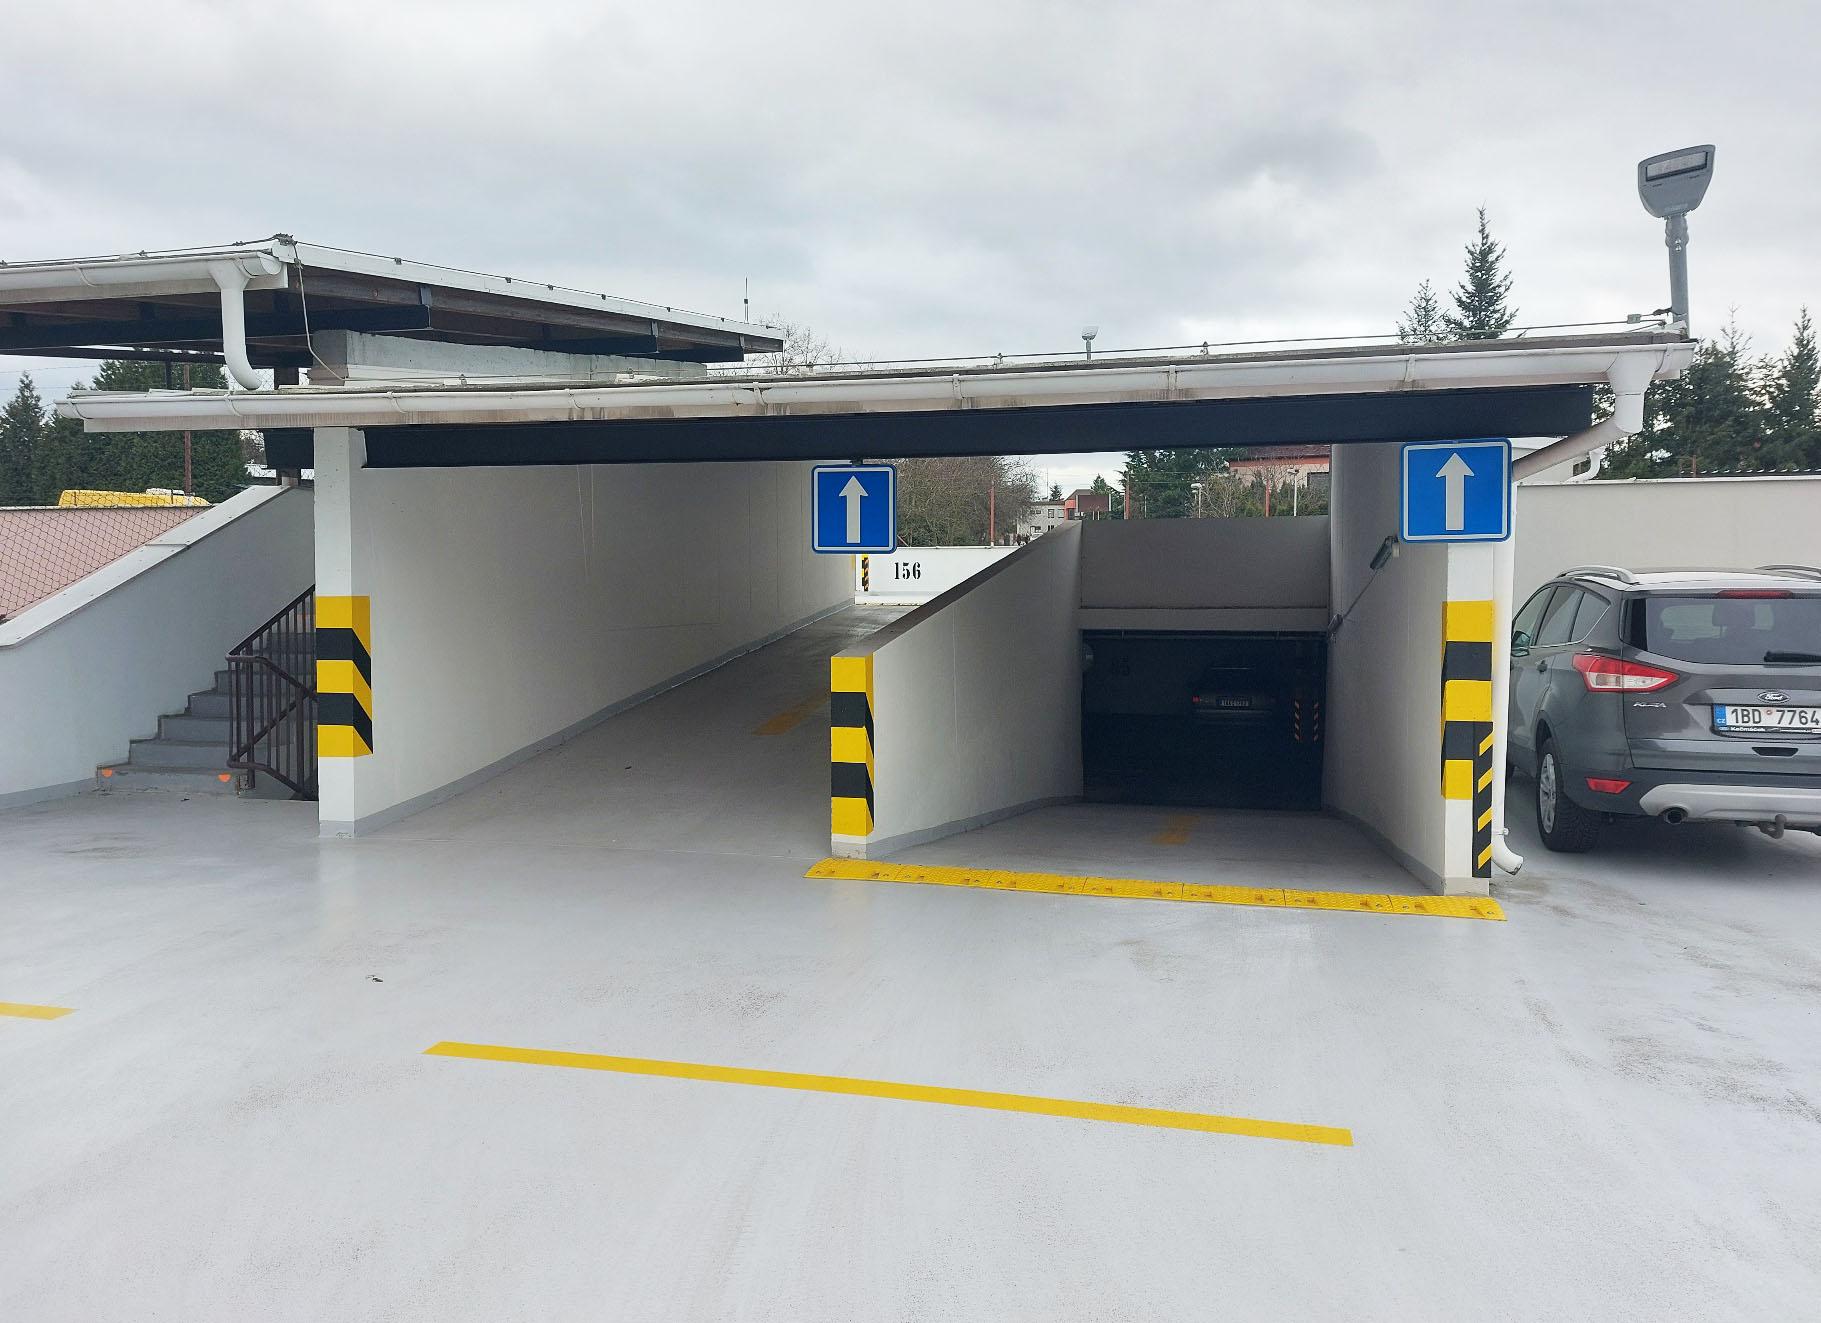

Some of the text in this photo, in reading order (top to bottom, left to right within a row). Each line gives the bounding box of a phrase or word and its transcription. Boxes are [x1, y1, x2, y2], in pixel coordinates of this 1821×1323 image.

[894, 562, 921, 580] 156
[1763, 692, 1785, 701] Ford
[1731, 708, 1820, 726] 1BD 7764
